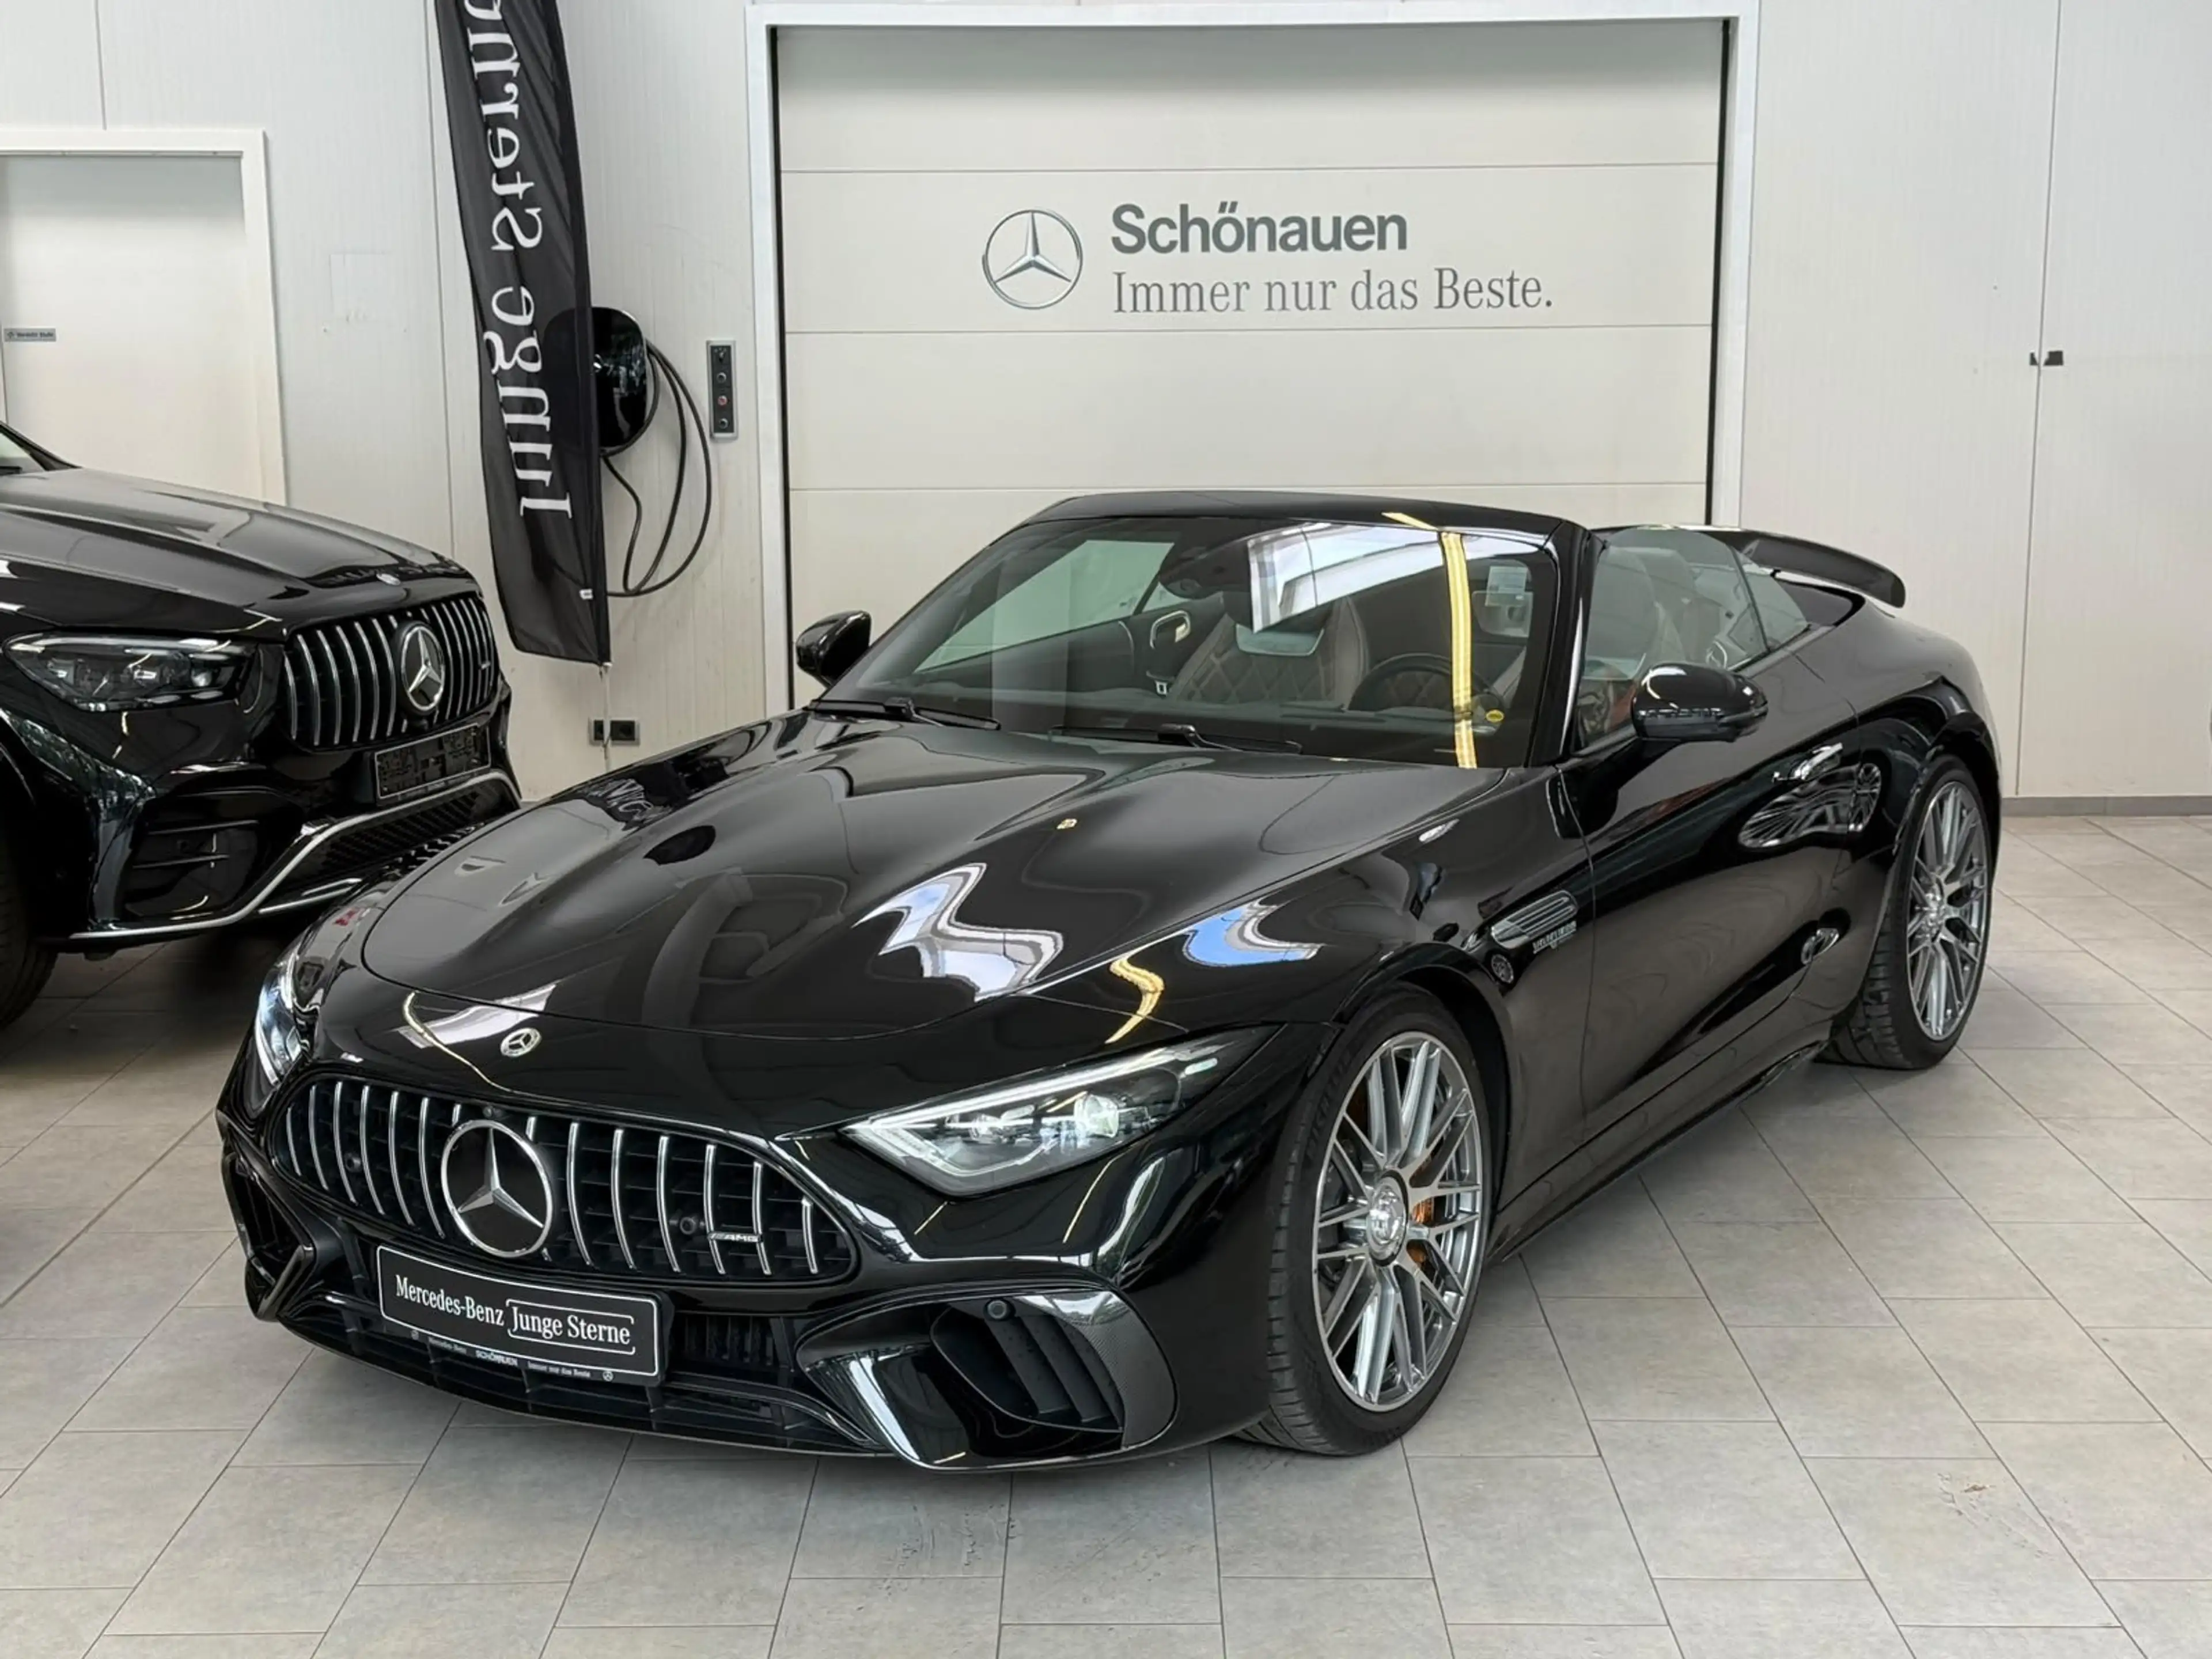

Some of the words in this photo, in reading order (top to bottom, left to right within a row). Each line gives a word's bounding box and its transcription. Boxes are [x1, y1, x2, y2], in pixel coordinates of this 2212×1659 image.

[1112, 201, 1407, 253] Schönauen
[1113, 271, 1251, 313] Immer
[1264, 281, 1337, 311] nur
[1351, 269, 1418, 311] das
[1434, 267, 1552, 309] Beste.
[724, 1234, 759, 1243] AMG
[395, 1274, 505, 1327] Mercedes-Benz
[512, 1306, 563, 1339] Junge
[567, 1315, 630, 1345] Sterne
